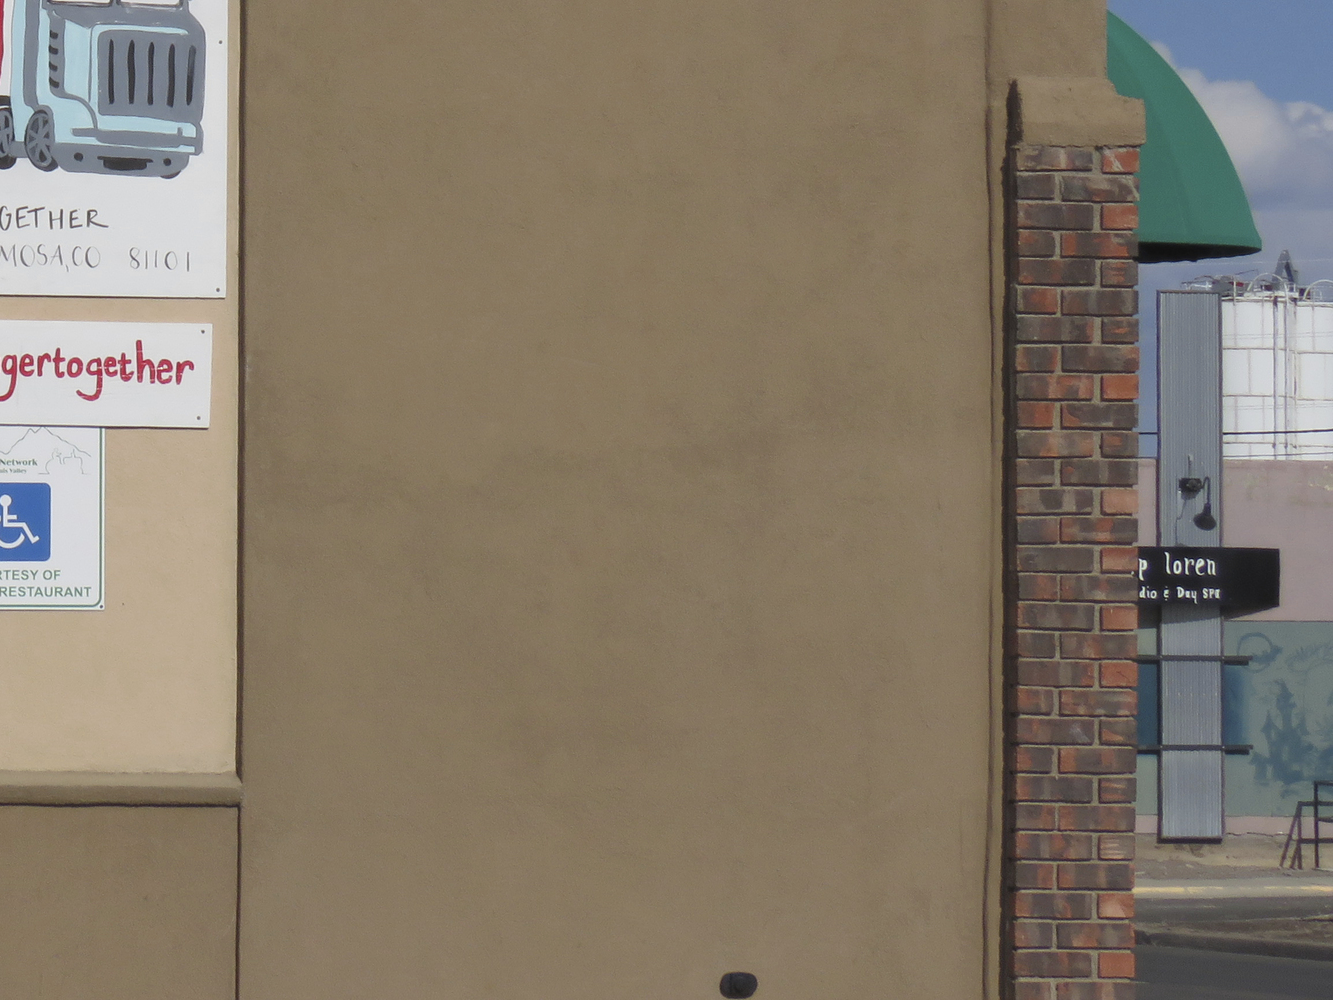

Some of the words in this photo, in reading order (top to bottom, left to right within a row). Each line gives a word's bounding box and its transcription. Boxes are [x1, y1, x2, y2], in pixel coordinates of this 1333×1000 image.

[129, 247, 191, 272] 81101
[0, 458, 37, 466] Network
[1164, 552, 1216, 575] loren
[43, 570, 61, 580] OF
[0, 586, 91, 597] RESTAURANT
[1177, 587, 1197, 604] Day
